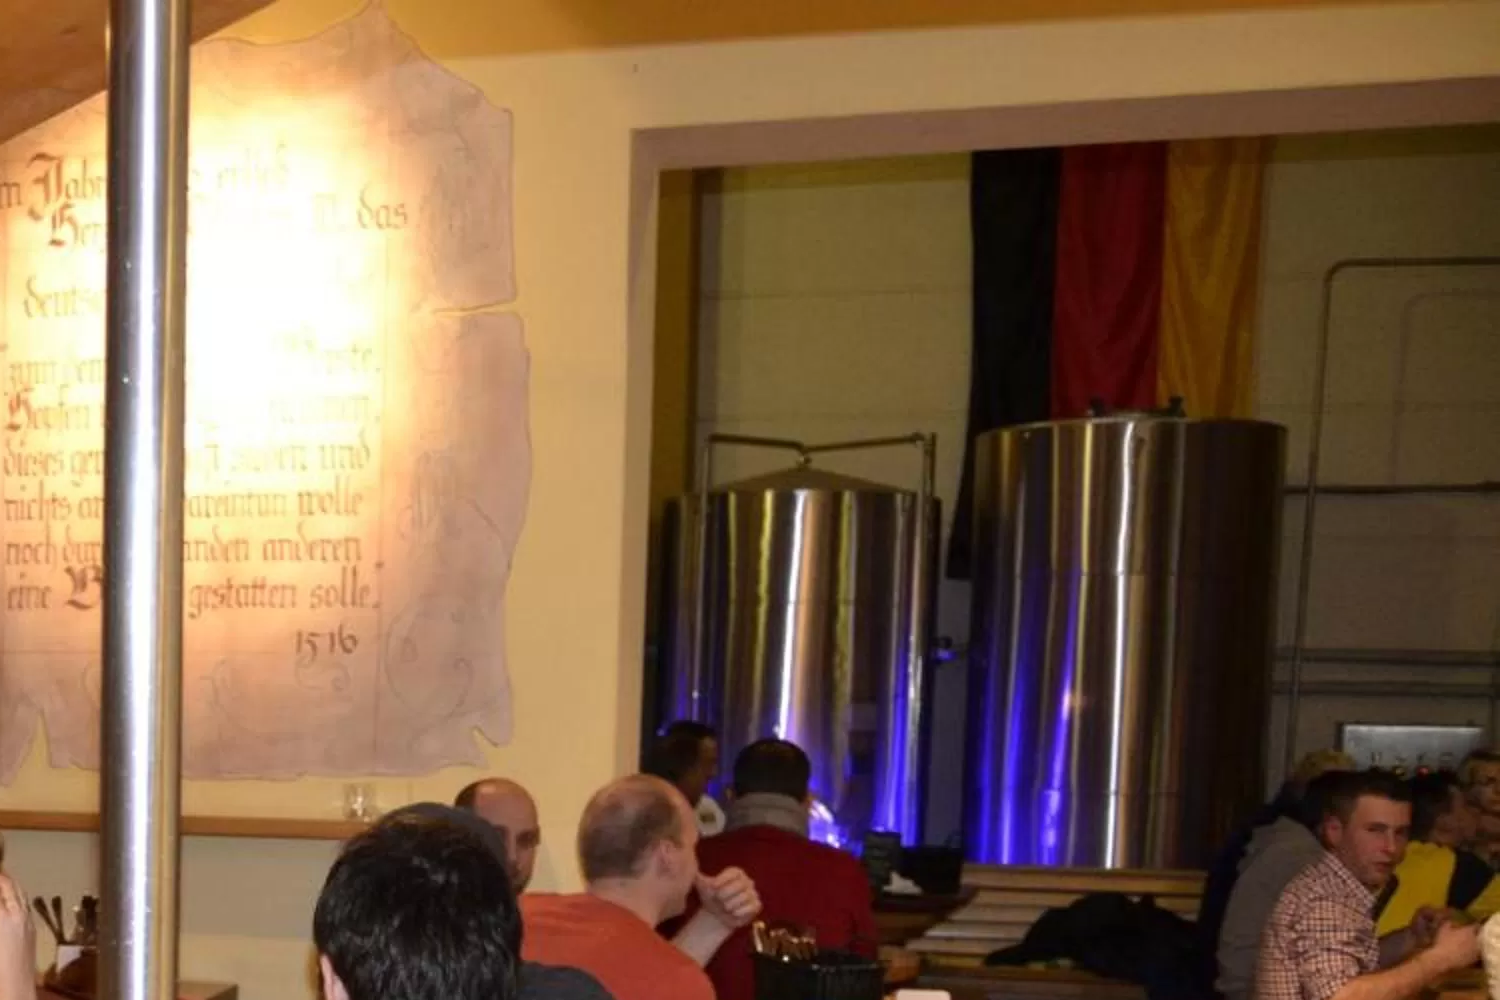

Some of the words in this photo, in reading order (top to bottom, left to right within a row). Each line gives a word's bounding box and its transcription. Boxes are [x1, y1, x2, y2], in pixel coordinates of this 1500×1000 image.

[356, 182, 409, 231] das
[318, 424, 371, 471] und
[297, 474, 364, 517] wolle
[261, 520, 363, 564] anderen
[6, 571, 53, 611] eine
[188, 575, 298, 620] gestatten
[295, 623, 360, 662] 1516
